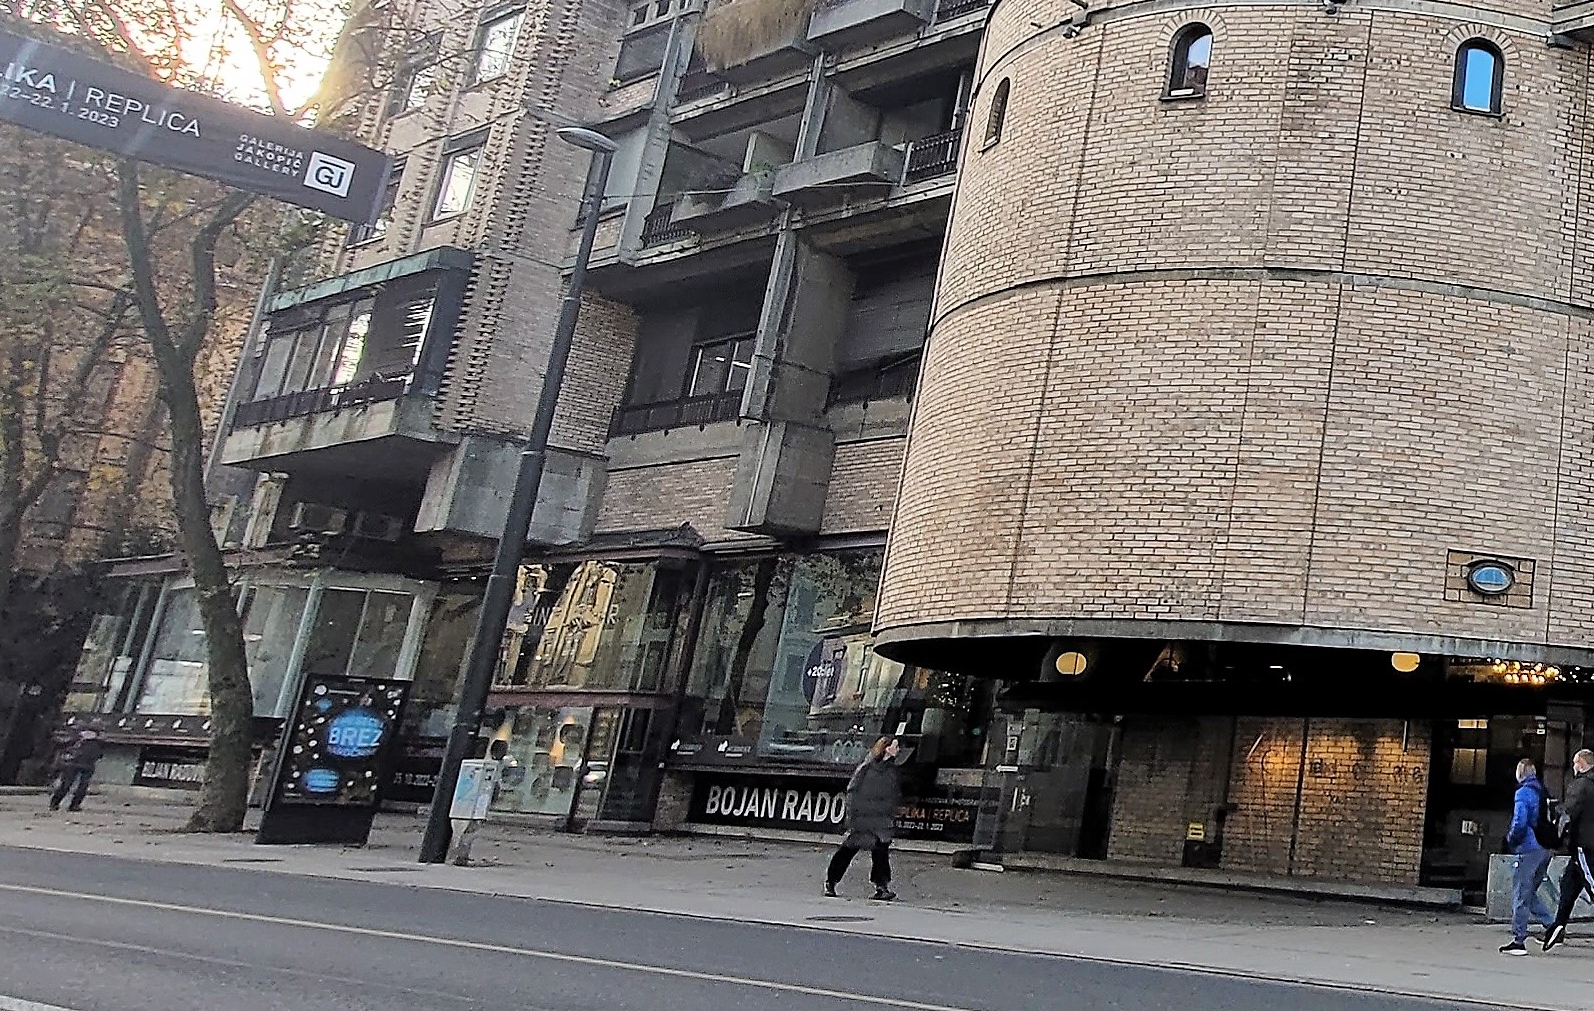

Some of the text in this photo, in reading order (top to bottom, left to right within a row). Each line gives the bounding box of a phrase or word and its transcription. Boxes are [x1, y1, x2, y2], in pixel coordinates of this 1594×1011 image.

[0, 62, 200, 138] IKA REPLICA
[78, 107, 119, 128] 2023
[239, 134, 303, 159] GALERIJA
[234, 152, 299, 177] GALLERY
[328, 726, 383, 747] BREZ
[706, 785, 846, 824] BOJAN RADO
